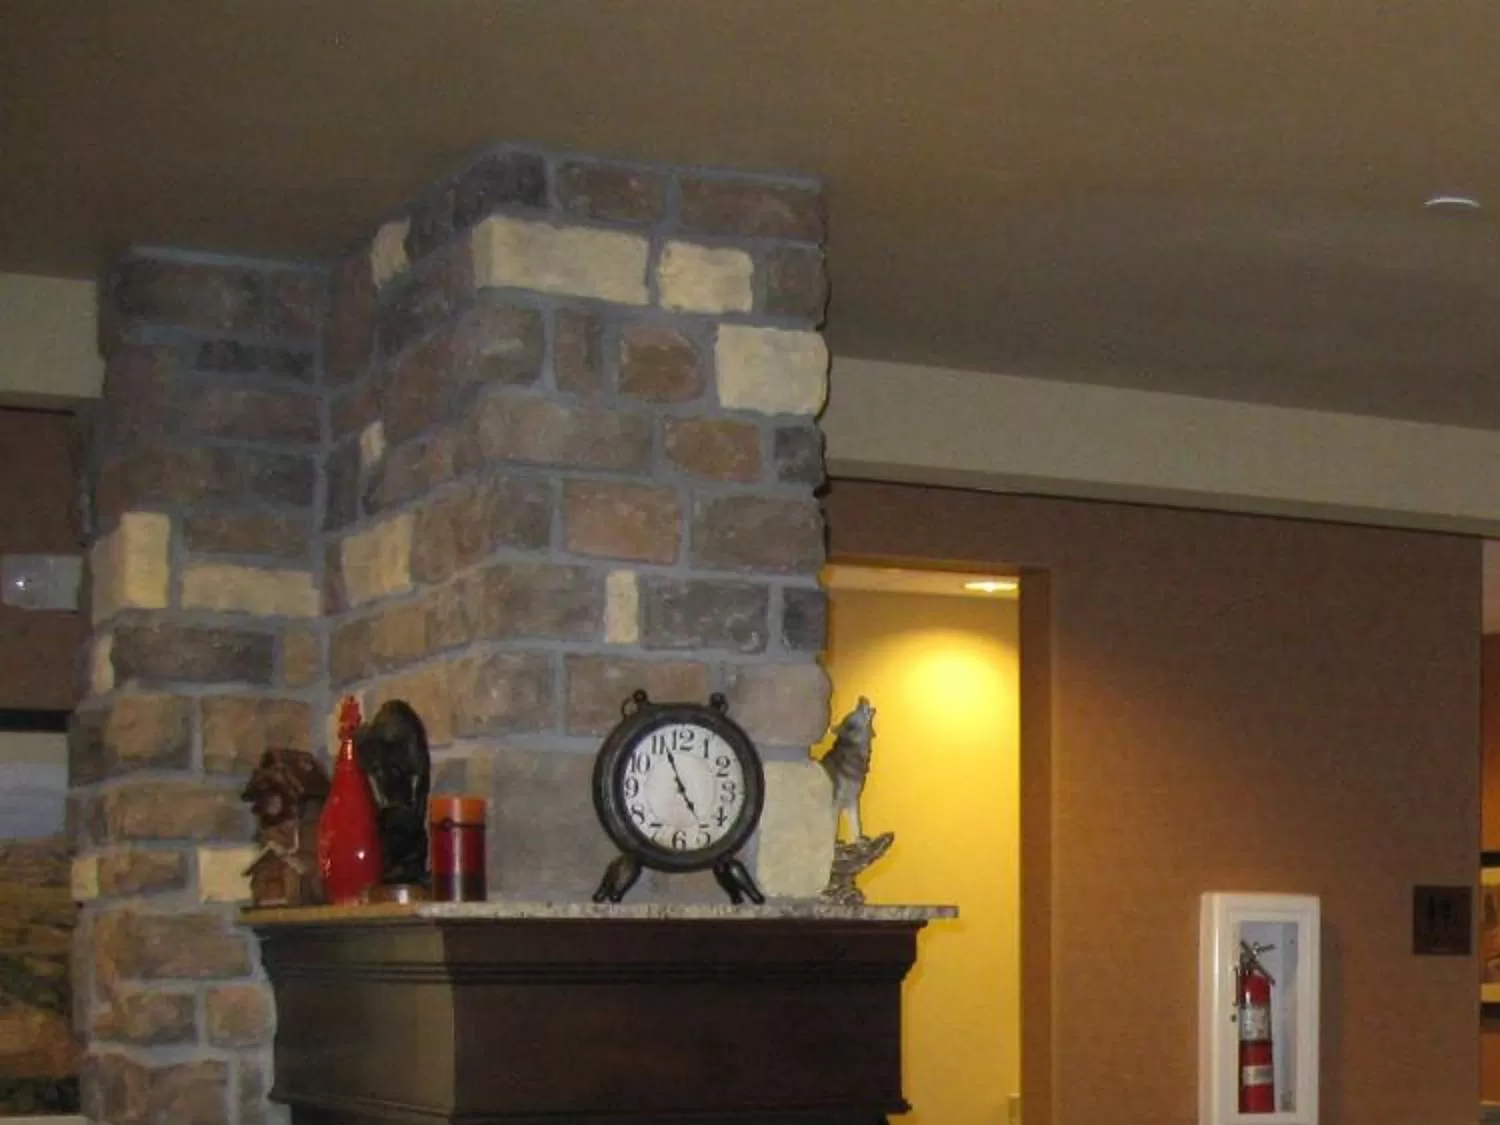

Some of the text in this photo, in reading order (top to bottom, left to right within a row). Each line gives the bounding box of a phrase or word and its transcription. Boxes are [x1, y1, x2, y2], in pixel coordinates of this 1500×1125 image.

[671, 729, 695, 752] 12
[703, 737, 710, 759] 1
[630, 754, 651, 773] 10
[715, 755, 731, 777] 2
[625, 776, 639, 798] 9
[721, 780, 736, 803] 3
[631, 804, 646, 825] 8
[712, 806, 728, 827] 4
[671, 830, 687, 851] 6
[695, 824, 711, 846] 5
